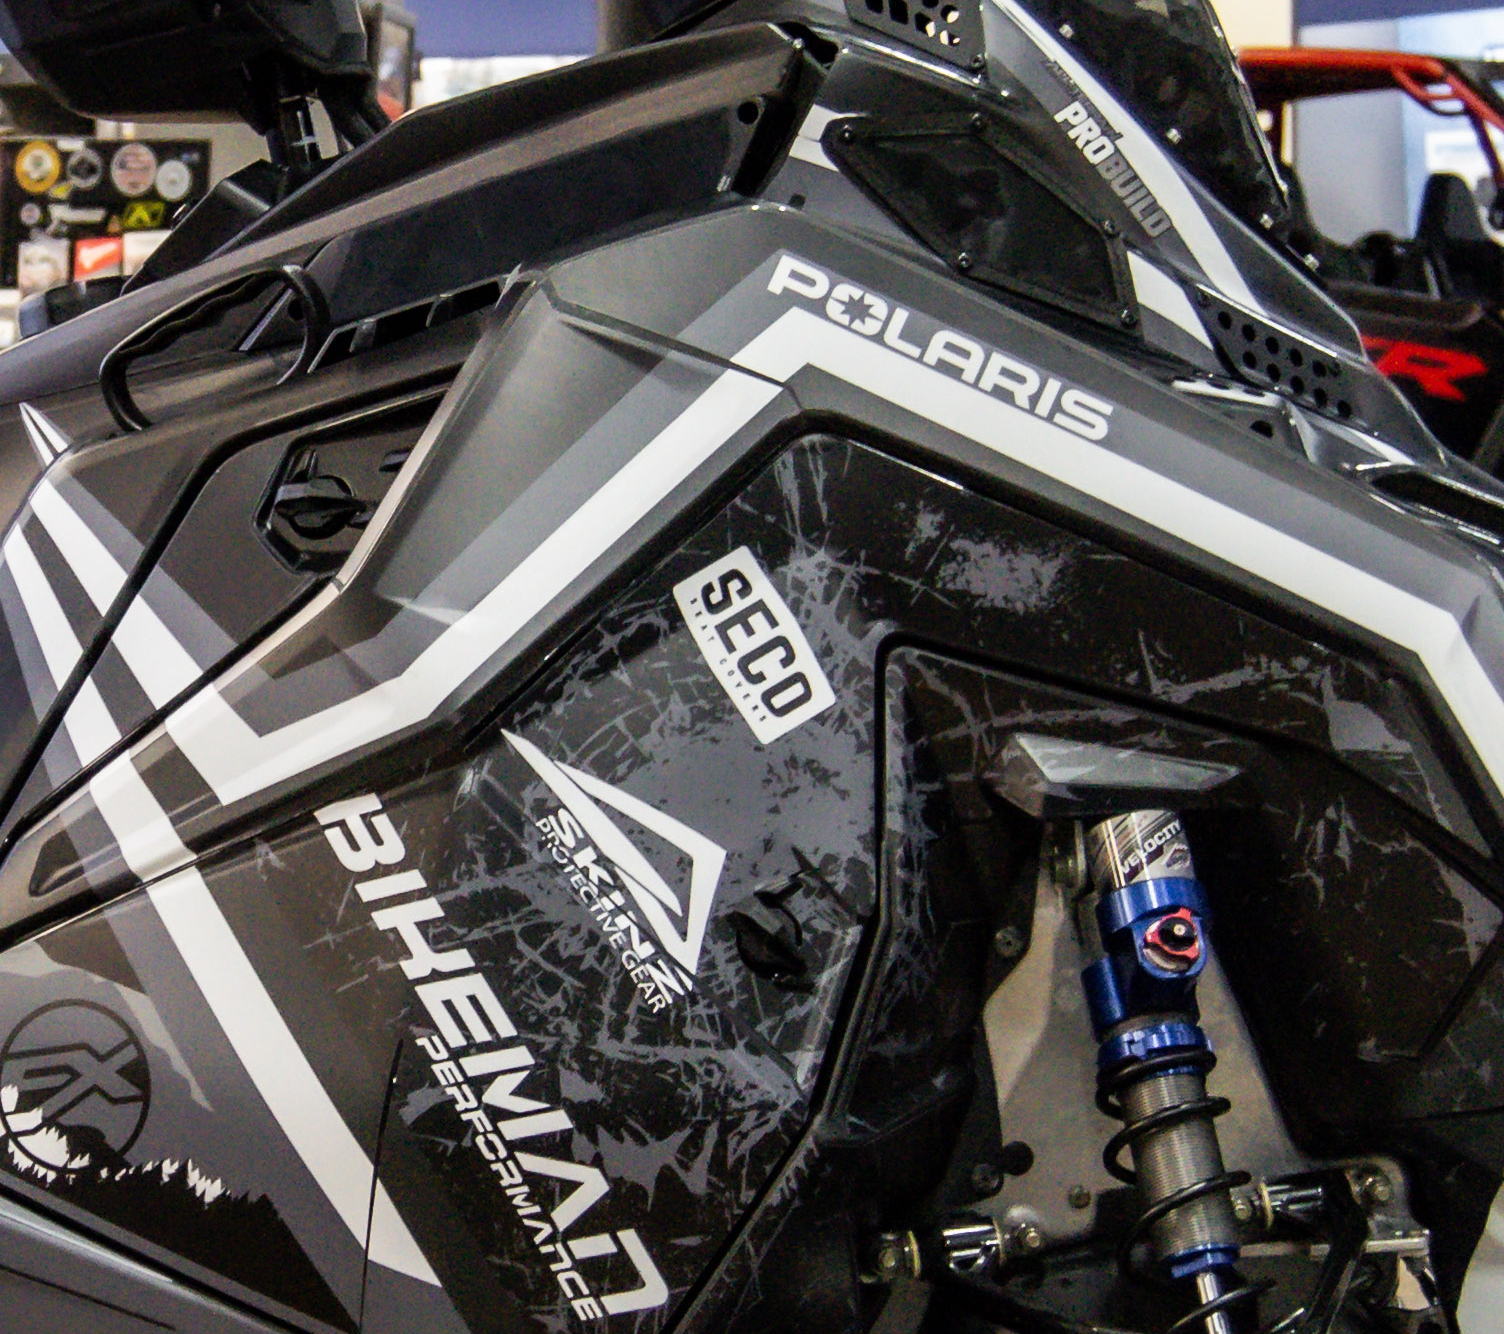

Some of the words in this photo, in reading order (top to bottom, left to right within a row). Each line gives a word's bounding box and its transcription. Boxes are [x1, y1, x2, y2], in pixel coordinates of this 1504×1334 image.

[1053, 100, 1173, 238] PROBUILD
[767, 254, 1114, 441] POLARIS
[690, 597, 714, 643] SEAT
[719, 657, 766, 723] COVERS
[700, 566, 814, 721] SECO
[534, 815, 626, 957] PROTECTIVE
[618, 943, 667, 1015] GEAR
[544, 804, 693, 1007] SKINZ
[1121, 818, 1182, 874] VELOCITY
[314, 793, 669, 1316] BIKEMAN
[413, 1033, 604, 1323] PERFORMANCE
